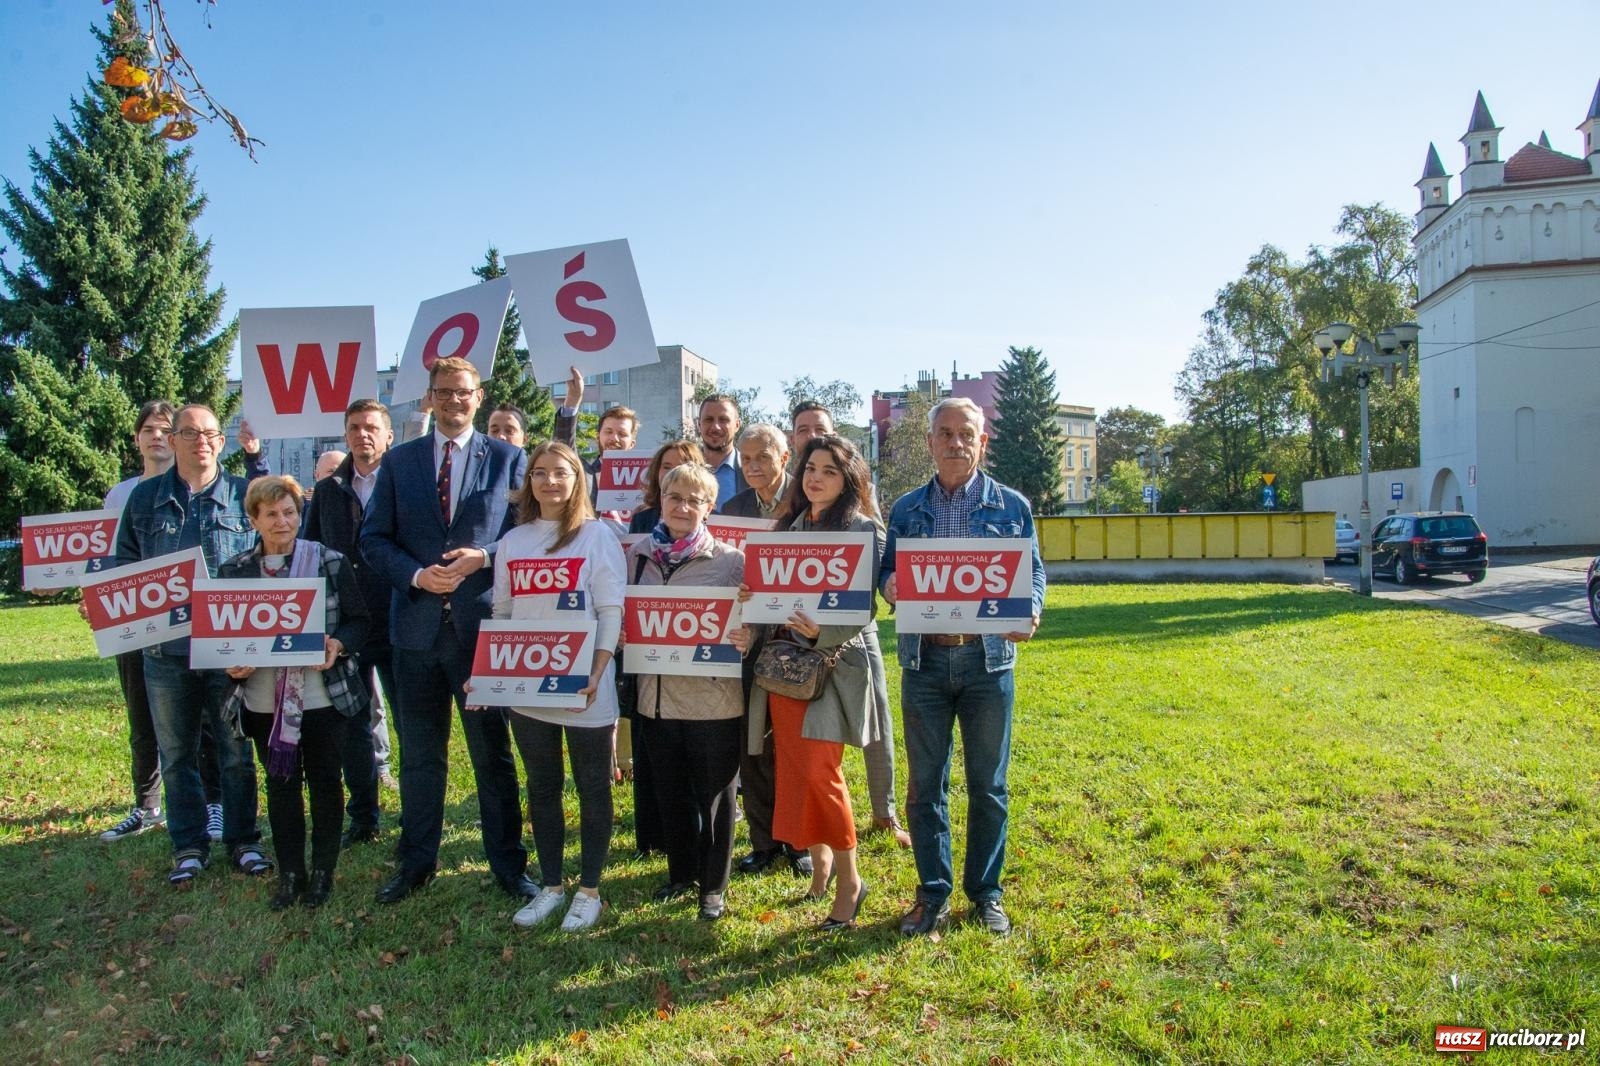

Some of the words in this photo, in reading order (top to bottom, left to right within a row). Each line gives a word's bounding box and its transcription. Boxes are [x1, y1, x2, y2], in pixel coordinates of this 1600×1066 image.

[256, 342, 361, 415] W
[422, 312, 480, 372] O
[555, 251, 616, 352] Ś
[34, 522, 108, 558] WOŚ
[729, 530, 746, 538] SEJM
[92, 559, 101, 570] 3
[759, 547, 848, 586] WOŚ
[513, 560, 570, 591] WOŚ
[911, 553, 1007, 593] WOŚ
[97, 585, 110, 594] DO
[112, 579, 137, 591] SEJMU
[99, 566, 189, 619] WOŚ
[568, 593, 578, 608] 3
[828, 593, 839, 608] 3
[987, 601, 998, 615] 3
[176, 608, 187, 620] 3
[208, 592, 302, 631] WOŚ
[637, 602, 720, 640] WOŚ
[281, 636, 292, 650] 3
[490, 634, 571, 671] WOŚ
[701, 646, 712, 660] 3
[547, 677, 558, 691] 3
